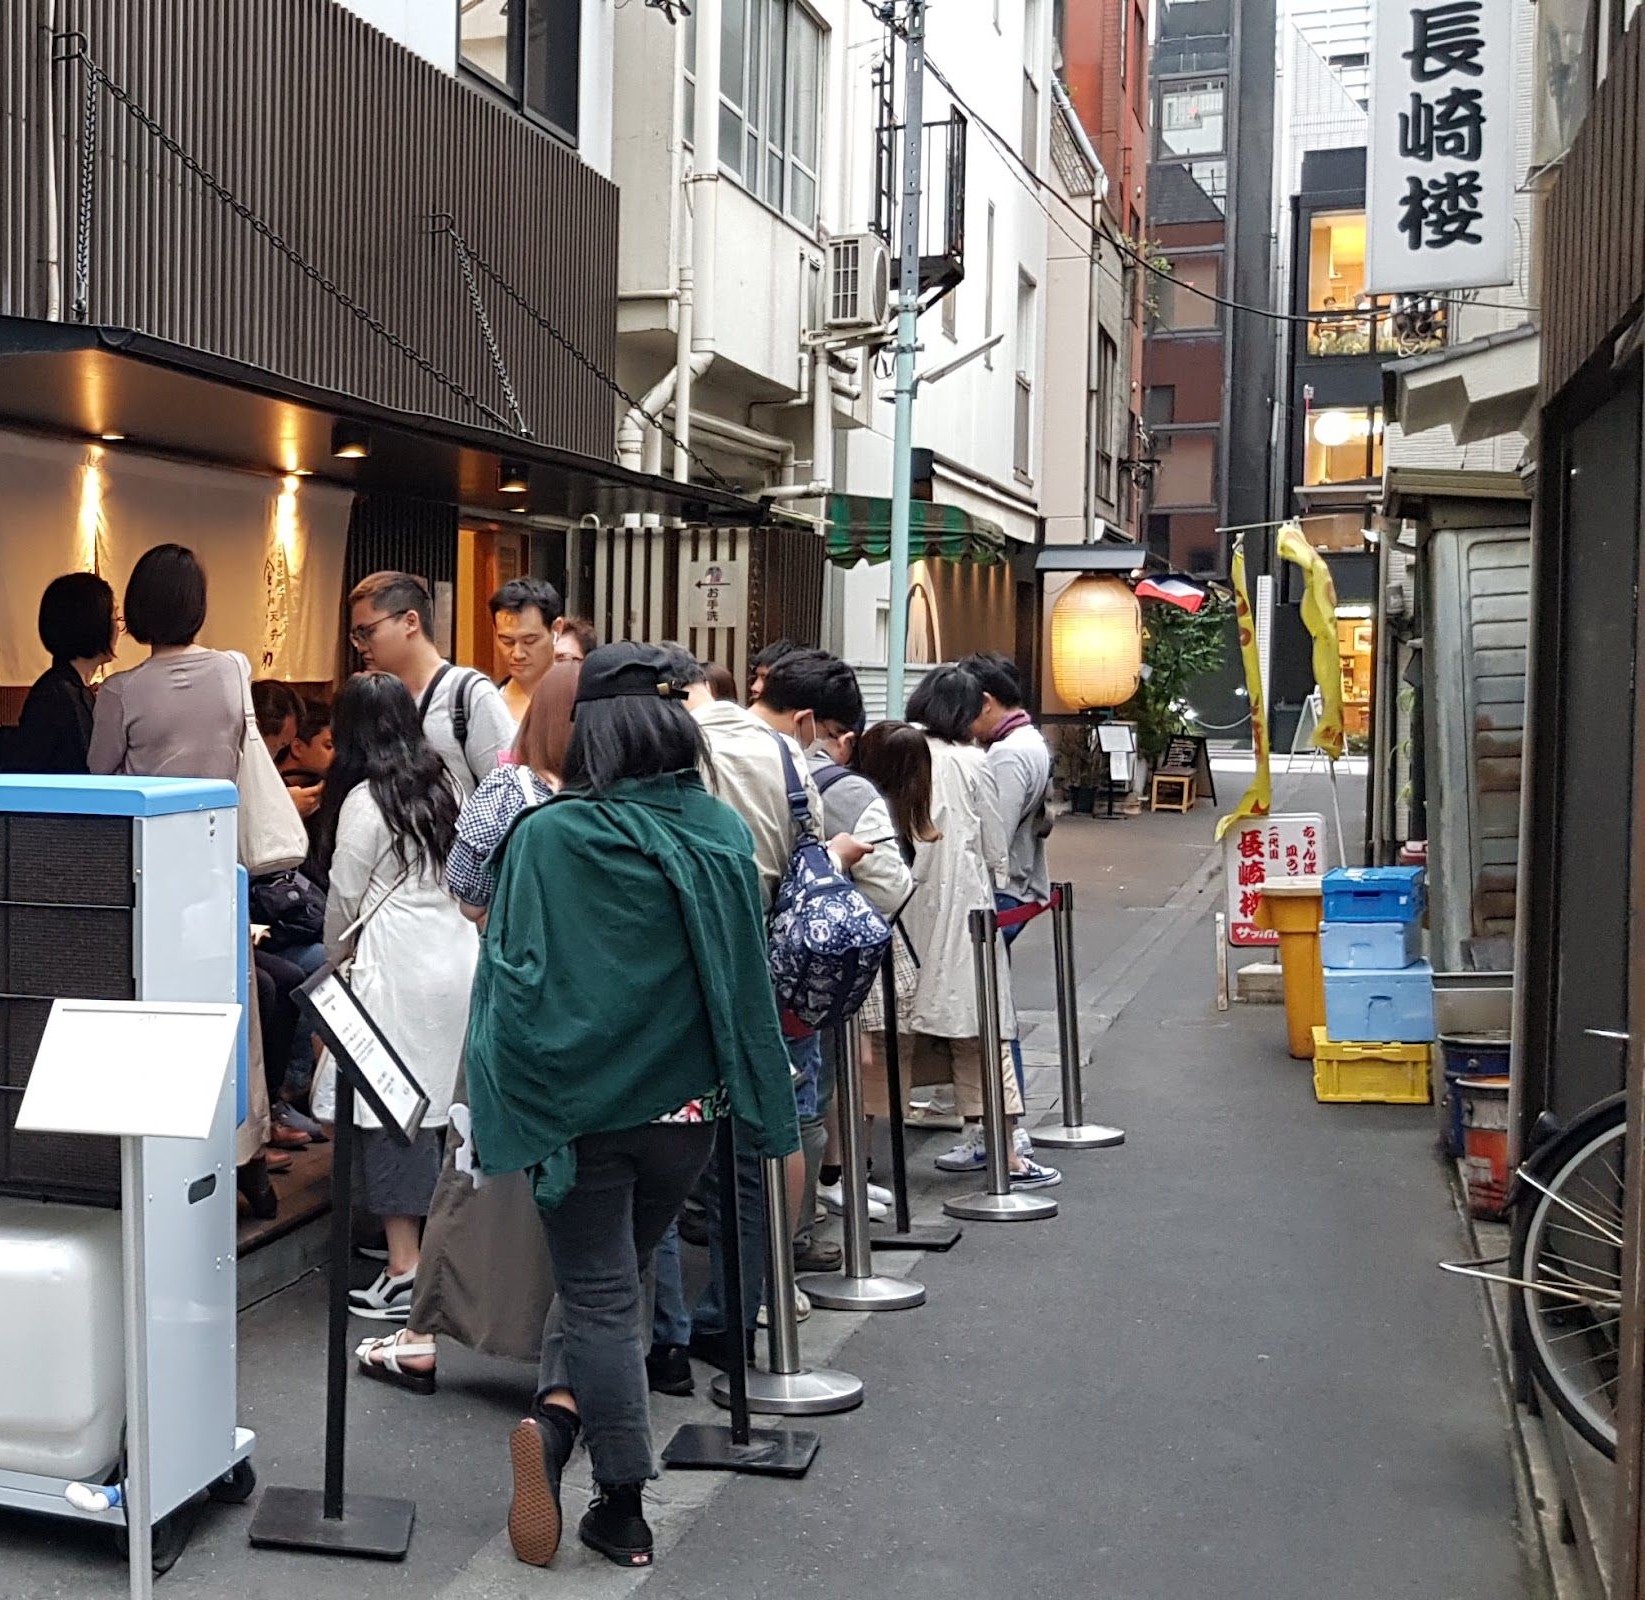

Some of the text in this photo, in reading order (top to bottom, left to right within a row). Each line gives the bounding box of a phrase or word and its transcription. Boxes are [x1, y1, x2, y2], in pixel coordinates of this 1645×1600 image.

[1397, 1, 1486, 250] 長崎楼
[707, 588, 719, 621] お手洗
[1285, 844, 1298, 876] 皿う
